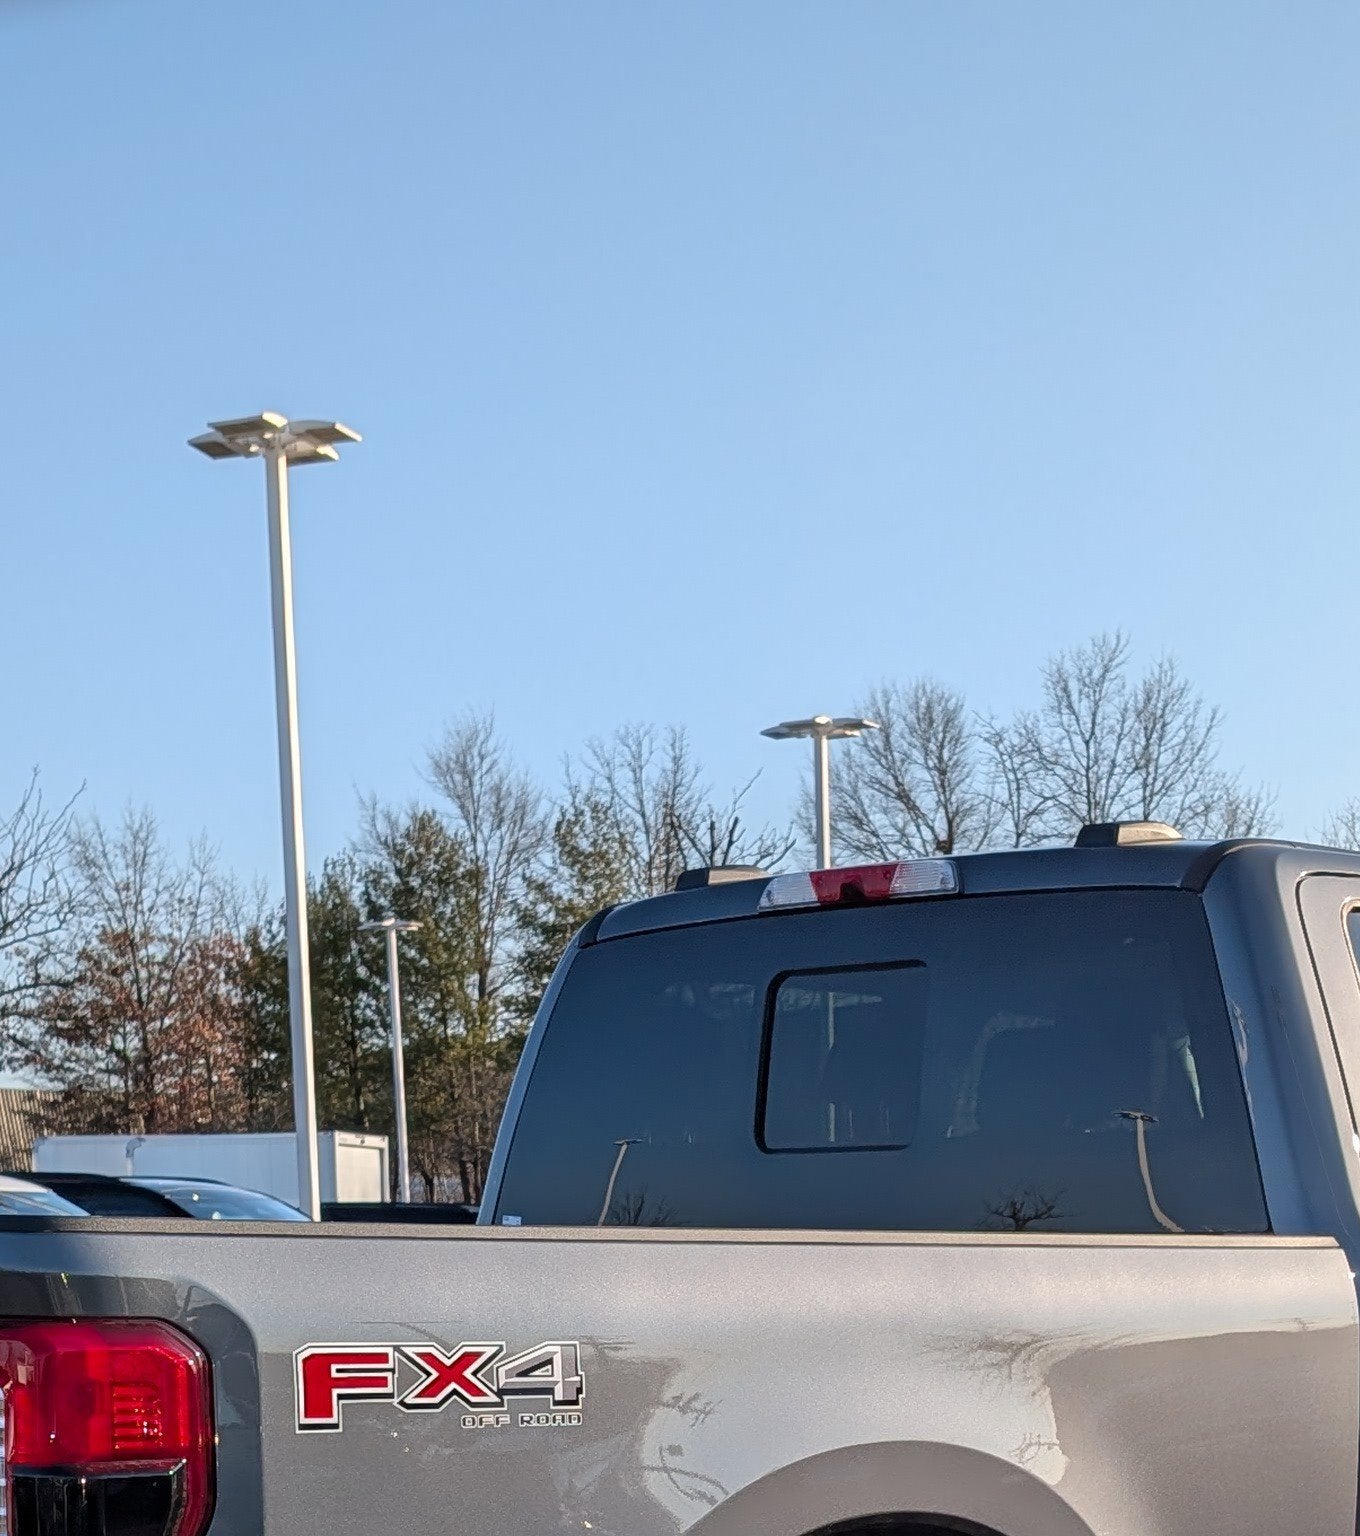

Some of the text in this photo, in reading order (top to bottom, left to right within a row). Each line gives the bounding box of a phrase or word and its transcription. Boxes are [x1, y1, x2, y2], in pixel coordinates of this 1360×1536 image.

[292, 1341, 585, 1434] FX4
[460, 1412, 583, 1428] OFF ROAD
